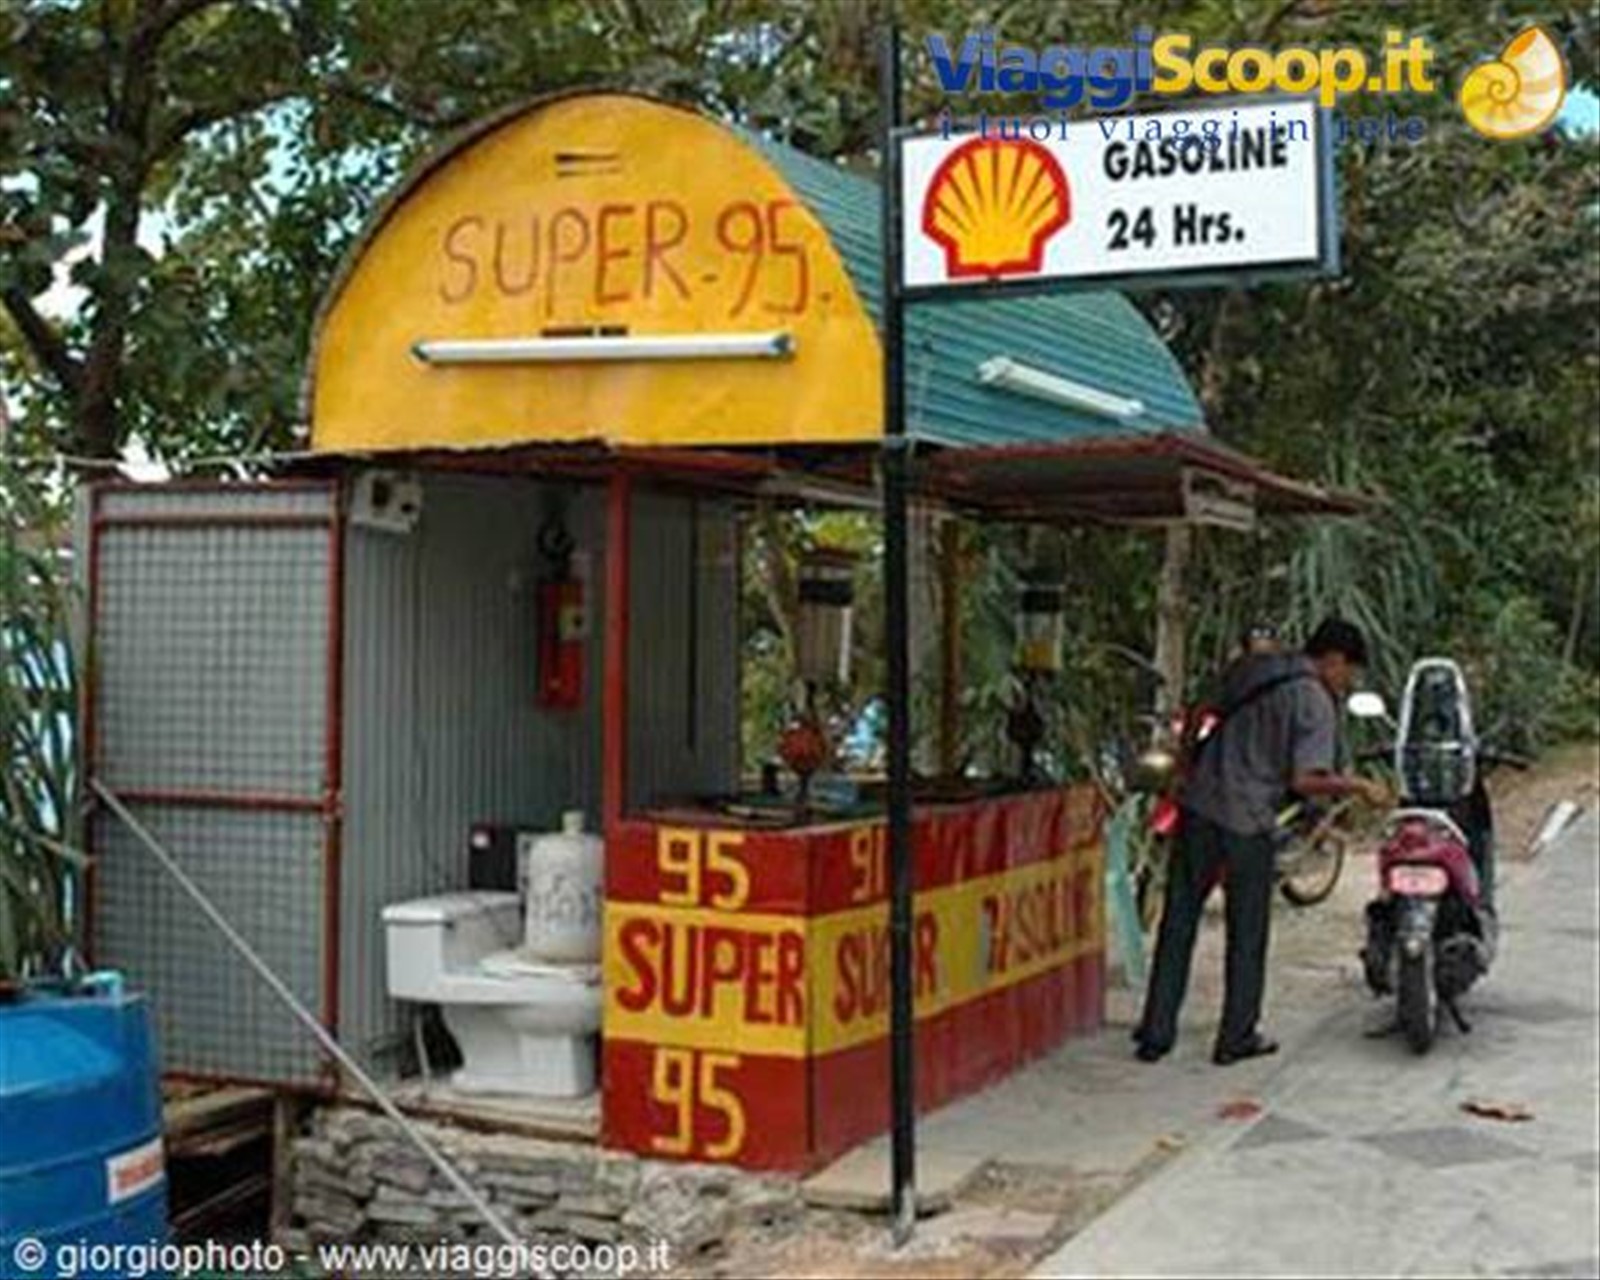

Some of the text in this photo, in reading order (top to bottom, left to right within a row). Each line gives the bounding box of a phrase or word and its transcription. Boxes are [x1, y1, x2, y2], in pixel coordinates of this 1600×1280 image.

[1103, 125, 1288, 182] GASOLINE
[1107, 202, 1246, 250] 24 Hrs.
[656, 827, 751, 911] 95
[616, 917, 806, 1027] SUPER
[834, 910, 939, 1023] SUR
[651, 1048, 749, 1161] 95
